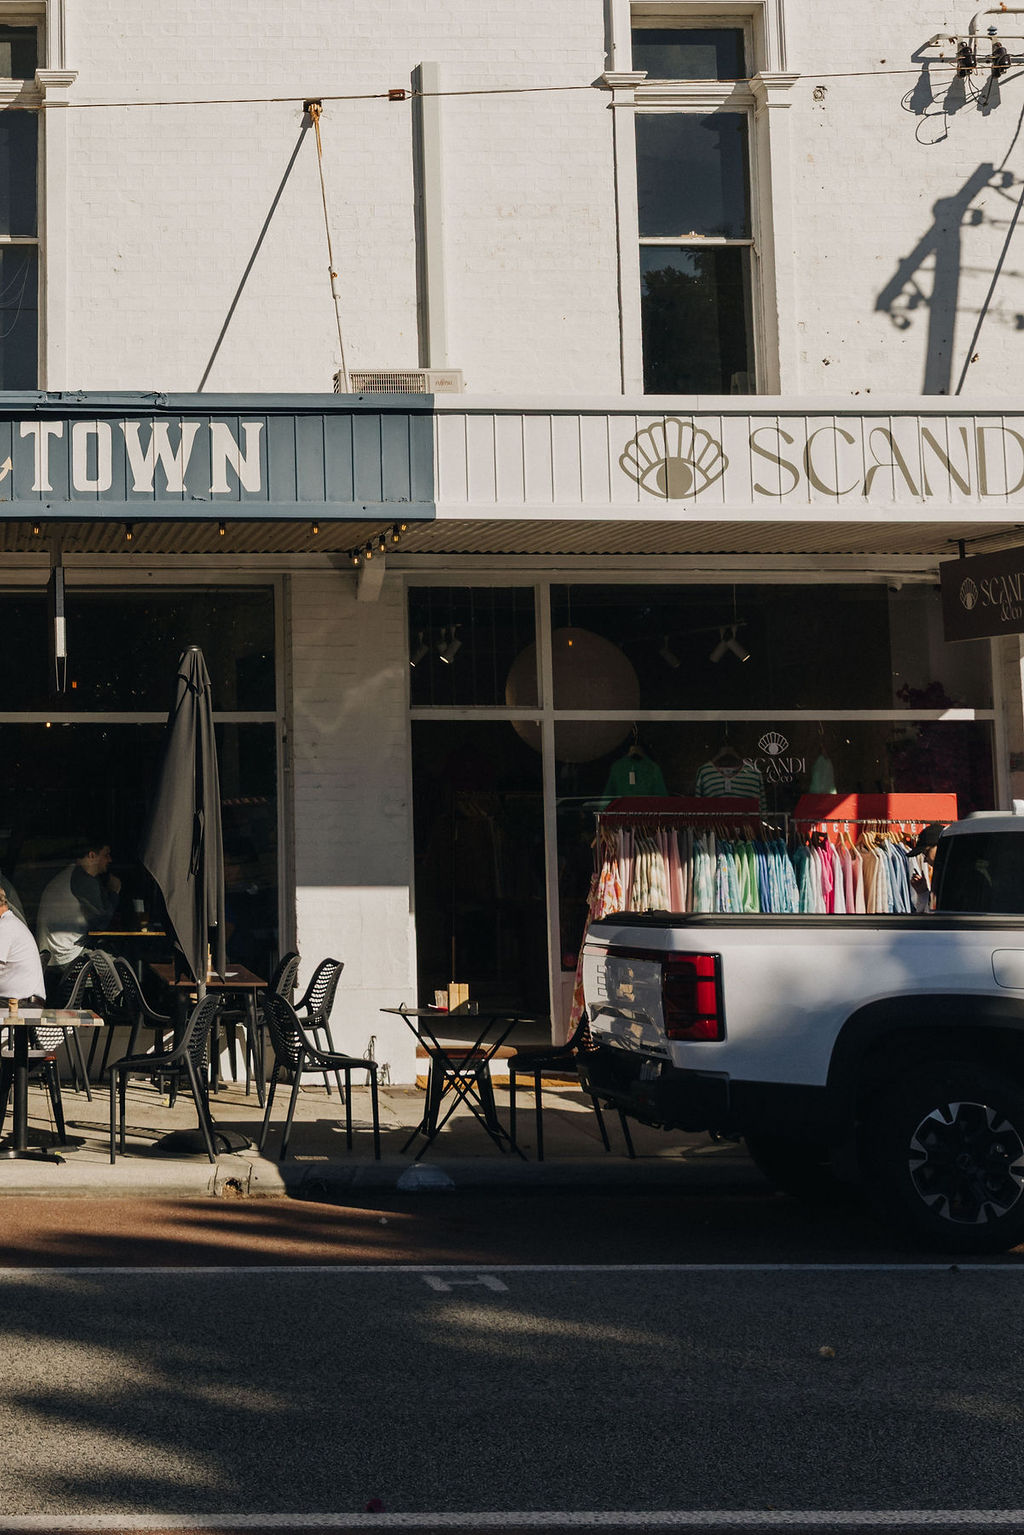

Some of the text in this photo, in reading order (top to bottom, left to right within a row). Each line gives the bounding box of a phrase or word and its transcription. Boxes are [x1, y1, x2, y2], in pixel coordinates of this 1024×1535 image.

[20, 421, 264, 493] TOWN
[749, 427, 1024, 496] SCAND
[742, 757, 806, 774] SCANDI
